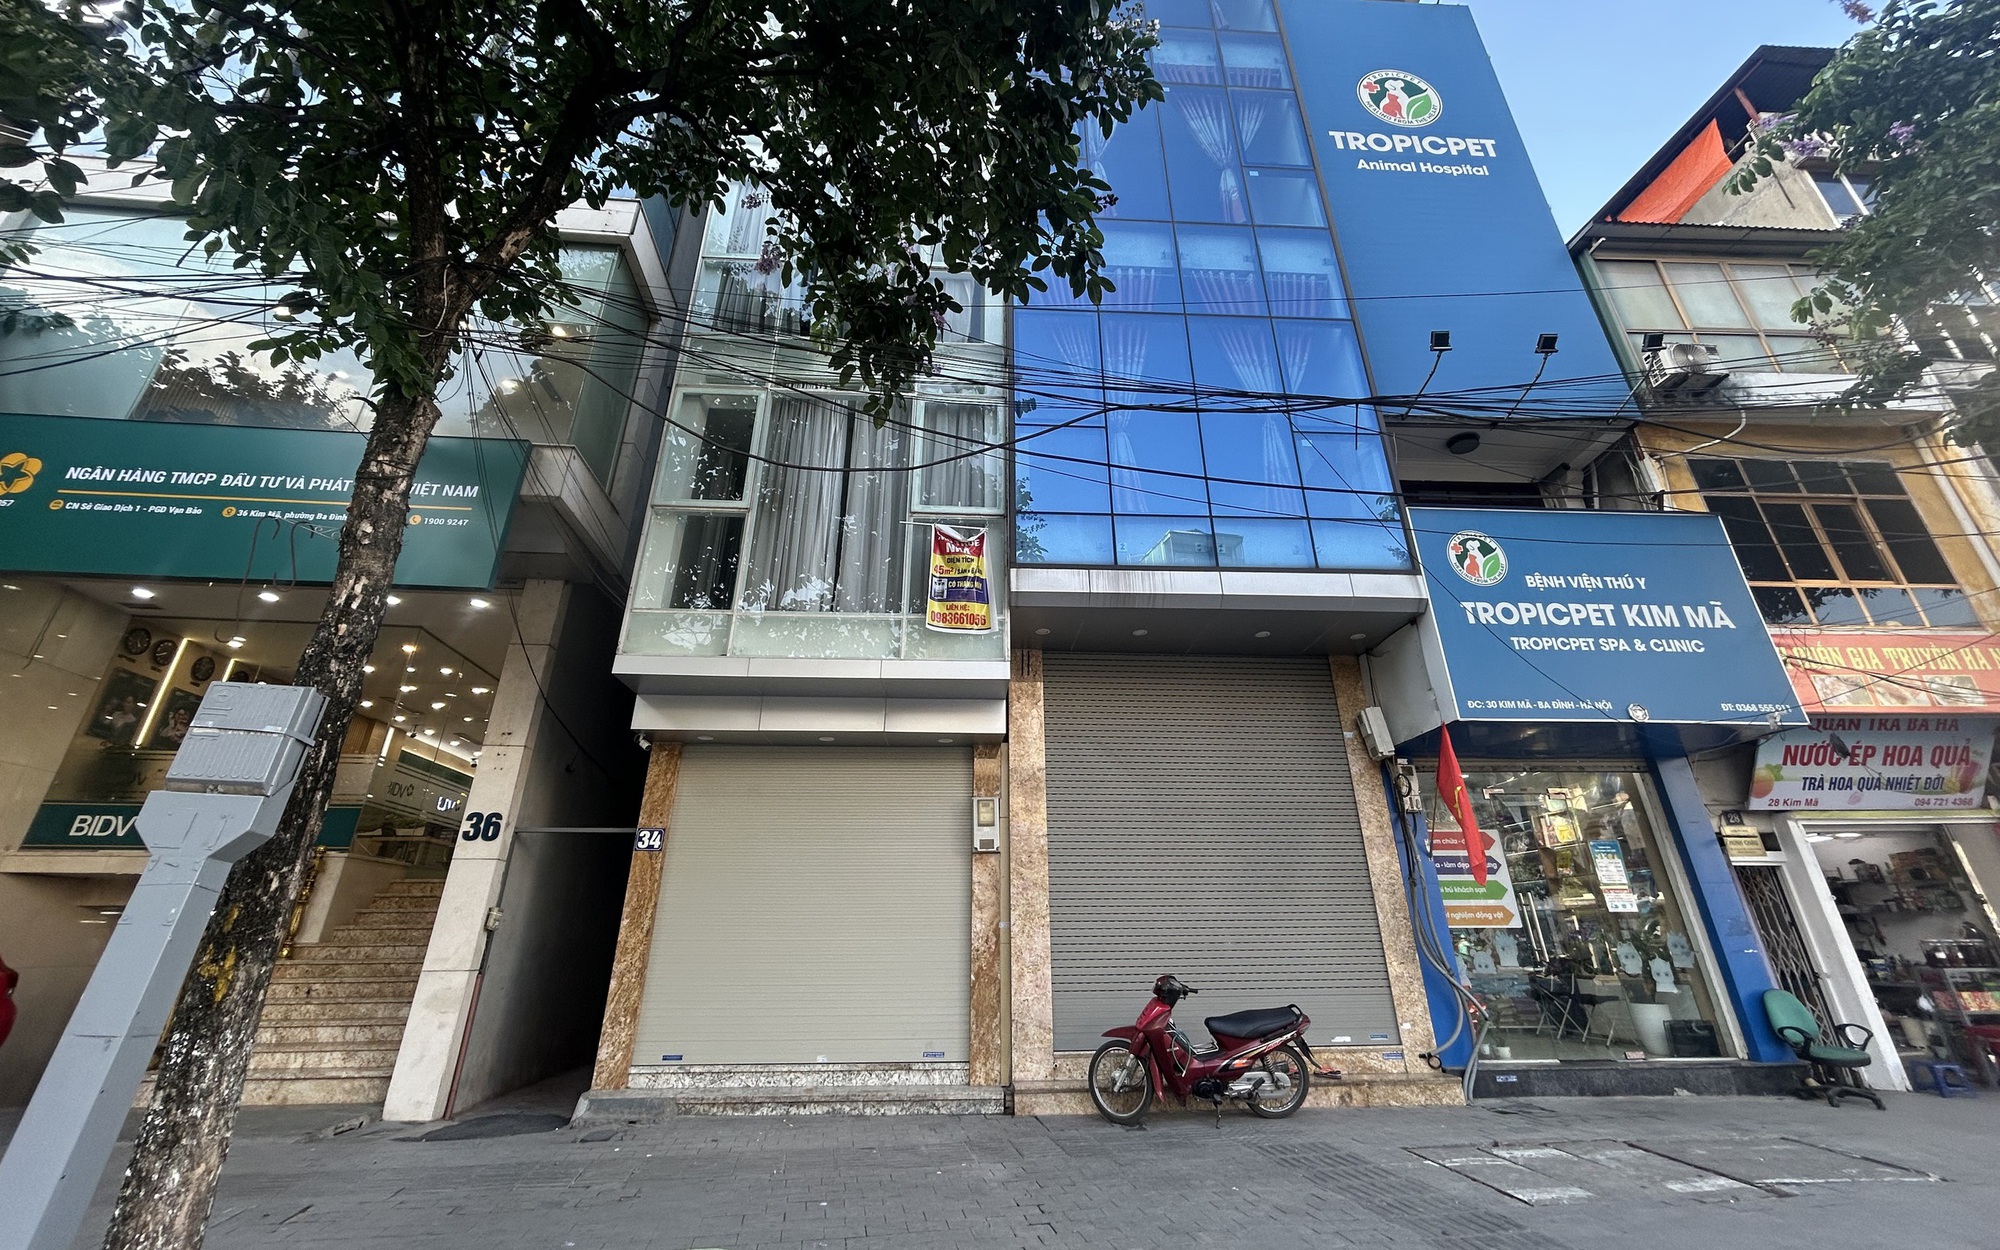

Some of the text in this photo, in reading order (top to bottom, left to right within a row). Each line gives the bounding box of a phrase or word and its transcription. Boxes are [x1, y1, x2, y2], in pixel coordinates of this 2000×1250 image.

[1328, 130, 1497, 158] TROPICPET
[1357, 158, 1489, 177] Animal Hospital
[65, 466, 116, 481] NGÂN
[116, 467, 167, 483] HÀNG
[170, 471, 217, 485] TMCP
[220, 472, 257, 488] ĐẦU
[260, 475, 284, 489] TƯ
[285, 475, 305, 490] VÀ
[308, 477, 354, 492] PHÁT
[442, 484, 479, 498] NAM
[65, 502, 79, 510] CN
[93, 503, 113, 511] Giao
[113, 504, 134, 513] Dịch
[148, 505, 167, 513] PGD
[237, 509, 248, 517] 36
[316, 512, 327, 520] Ba
[424, 517, 445, 525] 1900
[1525, 572, 1646, 592] BỆNH VIỆN THÚ Y
[931, 611, 987, 626] 0983661056
[1460, 600, 1737, 629] TROPICPET KIM MÃ
[1510, 636, 1705, 653] TROPICPET SPA & CLINIC
[1846, 646, 1885, 670] GIA
[1882, 642, 1965, 671] TRUYỀN
[1960, 645, 1992, 670] HÀ
[1467, 700, 1486, 709] ĐC:
[1486, 700, 1498, 709] 30
[1498, 700, 1516, 709] KIM
[1517, 698, 1533, 709] MÃ
[1538, 701, 1551, 709] BA
[1552, 699, 1575, 709] ĐÌNH
[1580, 699, 1595, 709] HÀ
[1595, 699, 1613, 711] NỘI
[1721, 703, 1735, 711] ĐT:
[1735, 703, 1758, 712] 0368
[1758, 704, 1775, 712] 555
[1848, 740, 1877, 766] ÉP
[1882, 745, 1926, 767] HOA
[1929, 738, 1971, 769] QUẢ
[1802, 774, 1825, 791] TRÀ
[1828, 777, 1853, 791] HOA
[1768, 799, 1780, 807] 28
[1782, 799, 1802, 807] Kim
[68, 815, 138, 836] BIDV
[462, 812, 503, 841] 36
[1727, 813, 1741, 823] 28
[637, 830, 661, 849] 34
